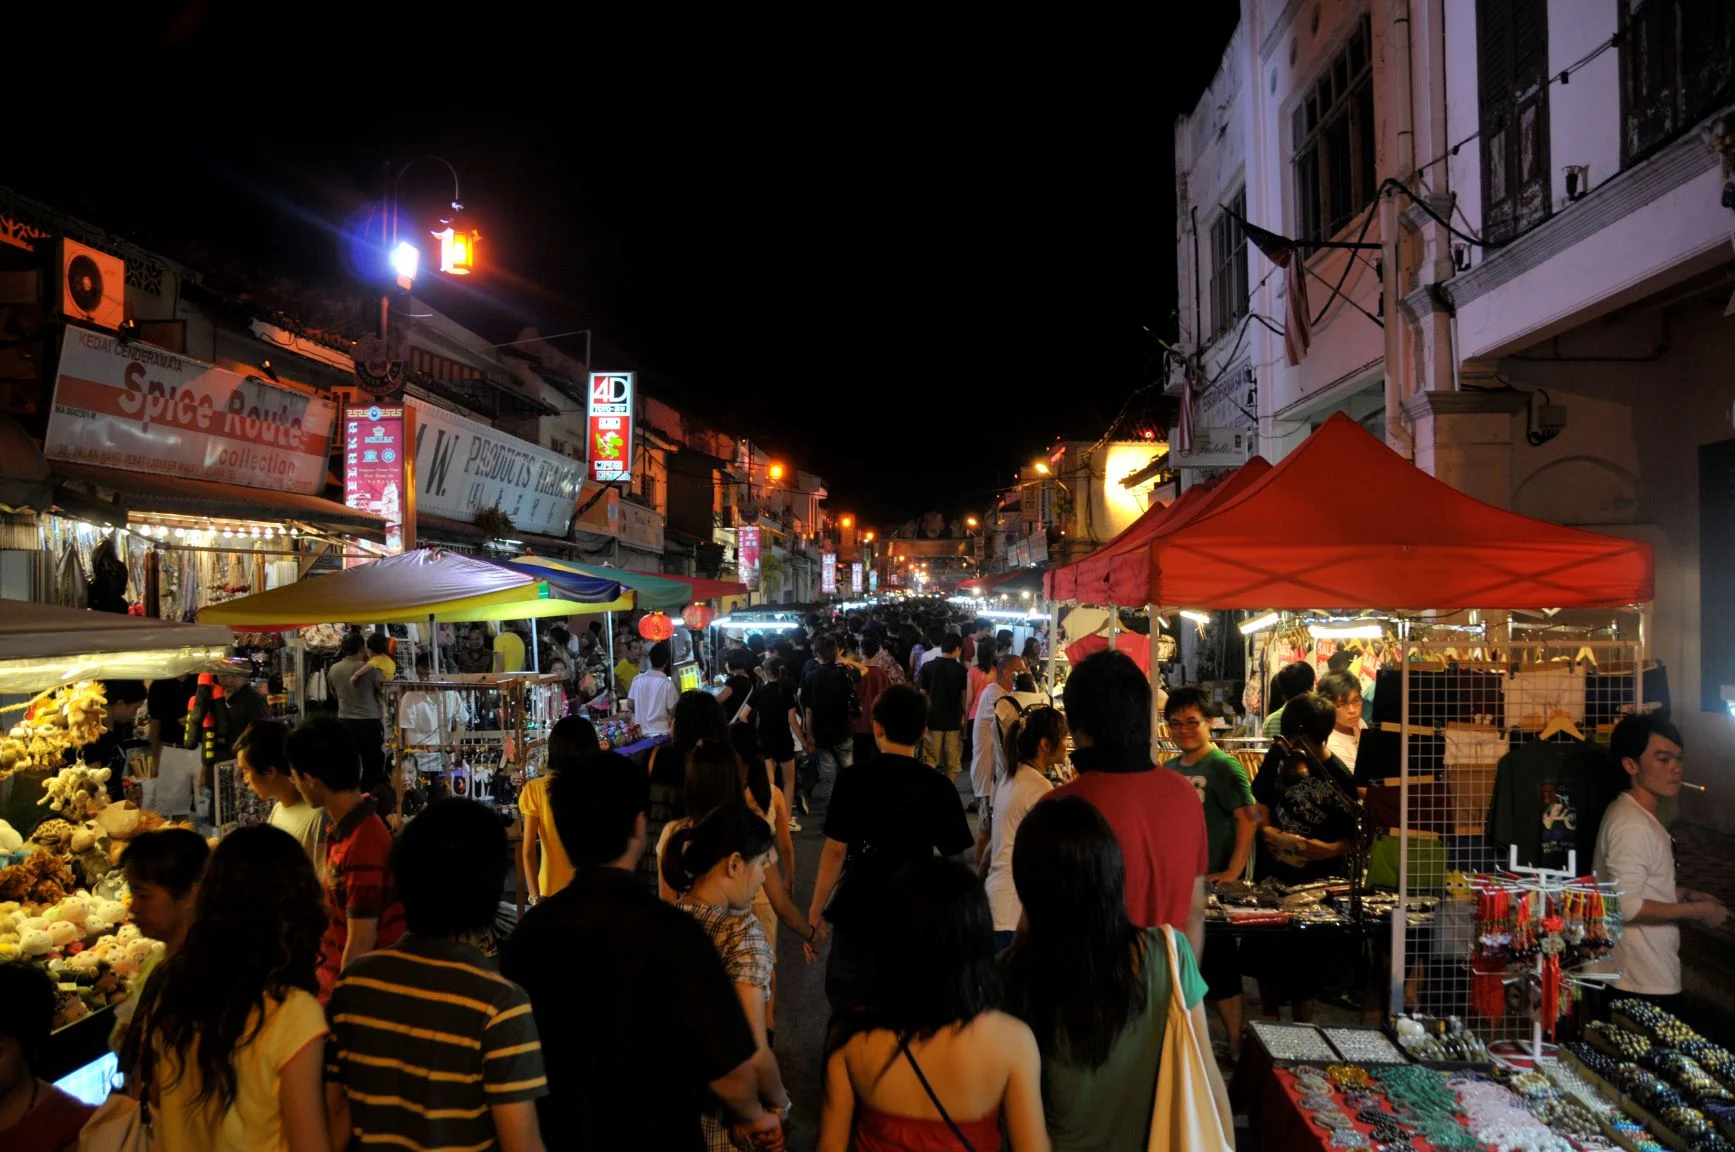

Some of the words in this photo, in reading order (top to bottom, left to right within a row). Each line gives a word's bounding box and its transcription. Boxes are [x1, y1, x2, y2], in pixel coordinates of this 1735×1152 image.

[78, 333, 112, 352] KEDAI
[113, 344, 183, 373] CENDERAMATA
[118, 361, 214, 434] Spice
[593, 376, 628, 404] 4D
[218, 447, 296, 476] collection
[1316, 641, 1338, 654] SALE
